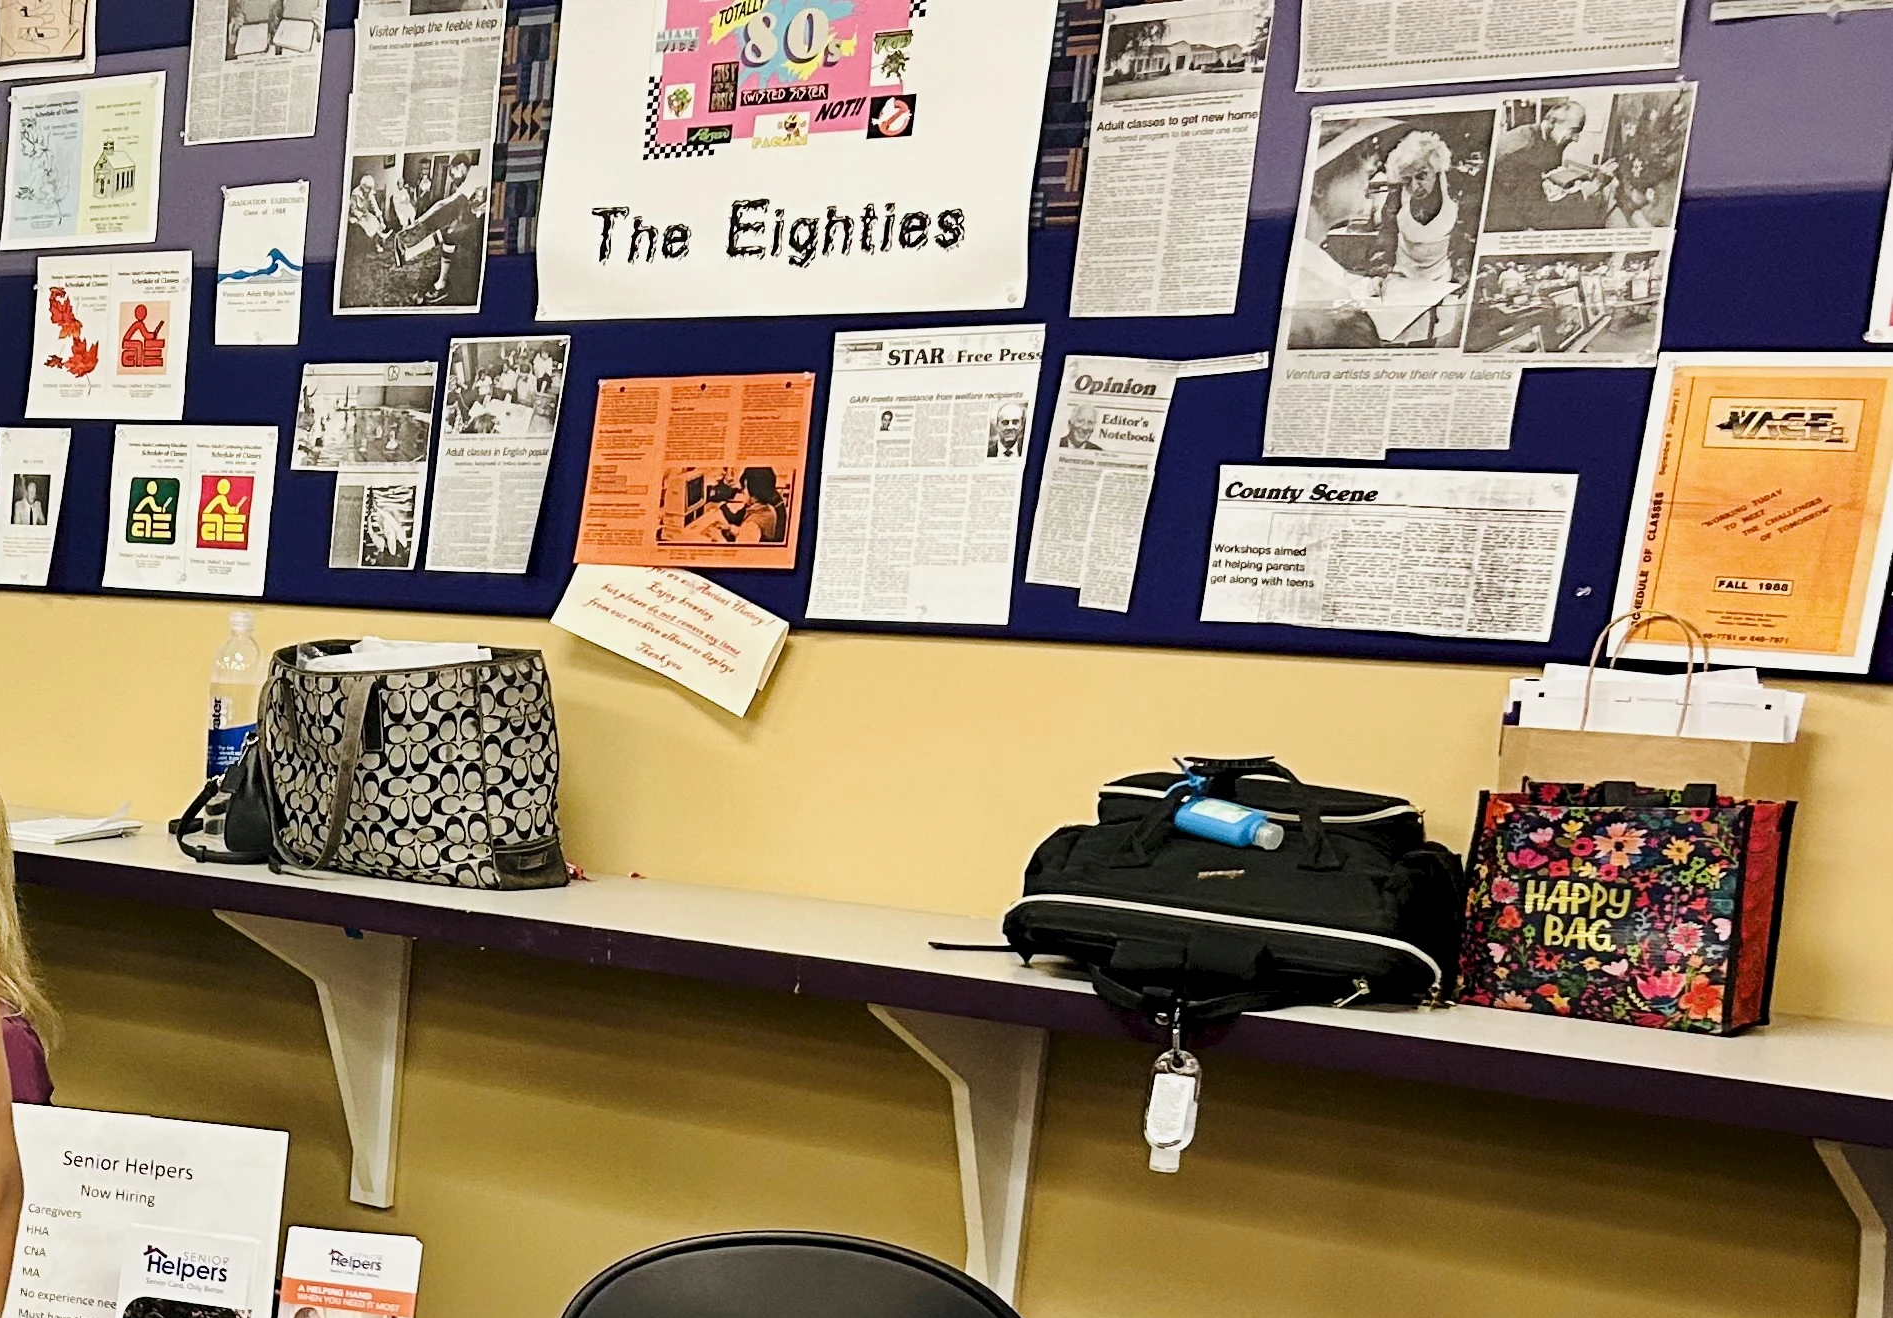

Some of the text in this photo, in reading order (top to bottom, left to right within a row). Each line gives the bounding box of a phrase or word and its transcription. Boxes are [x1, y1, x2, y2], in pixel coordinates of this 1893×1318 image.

[369, 17, 498, 38] Visitor helps the feeble keep
[656, 27, 700, 41] MIAMI
[739, 7, 844, 68] 80s
[742, 84, 828, 105] TWISTED SISTER
[814, 97, 866, 123] NOT!!
[1097, 110, 1258, 132] Adult classes to get new home
[592, 198, 966, 268] The Eighties
[887, 347, 1043, 366] STAR Free Press
[1074, 374, 1158, 396] Opinion
[1286, 368, 1513, 381] Ventura artists show their new talents
[1101, 413, 1149, 428] Editor's
[1097, 428, 1156, 443] Notebook
[445, 447, 465, 457] Adult
[467, 448, 492, 457] classes
[493, 447, 501, 457] in
[503, 446, 528, 458] English
[1224, 480, 1379, 504] County Scene
[1752, 488, 1784, 507] TODAY
[1646, 491, 1664, 542] CLASSES
[1214, 543, 1307, 558] Workshops aimed
[1642, 548, 1653, 563] OF
[1211, 559, 1306, 573] at helping parents
[1210, 575, 1315, 588] get along with teens
[646, 581, 677, 604] Enjoy
[584, 598, 609, 613] from
[610, 609, 628, 621] our
[627, 616, 660, 636] archive
[661, 628, 694, 651] albums
[600, 583, 741, 656] but please do not remove any items
[635, 641, 683, 673] Thank you
[1524, 879, 1632, 920] HAPPY
[1543, 913, 1617, 953] BAG
[62, 1150, 194, 1181] Senior Helpers
[80, 1184, 156, 1208] Now Hiring
[28, 1203, 83, 1219] Caregivers
[25, 1224, 50, 1237] HHA
[23, 1245, 47, 1258] CNA
[22, 1266, 41, 1278] MA
[146, 1254, 228, 1283] Helpers
[330, 1255, 382, 1271] Helpers
[20, 1287, 35, 1299] No
[37, 1289, 95, 1308] experience
[297, 1284, 373, 1300] A HELPING HAND
[296, 1293, 401, 1313] WHEN YOU NEED IT MOST
